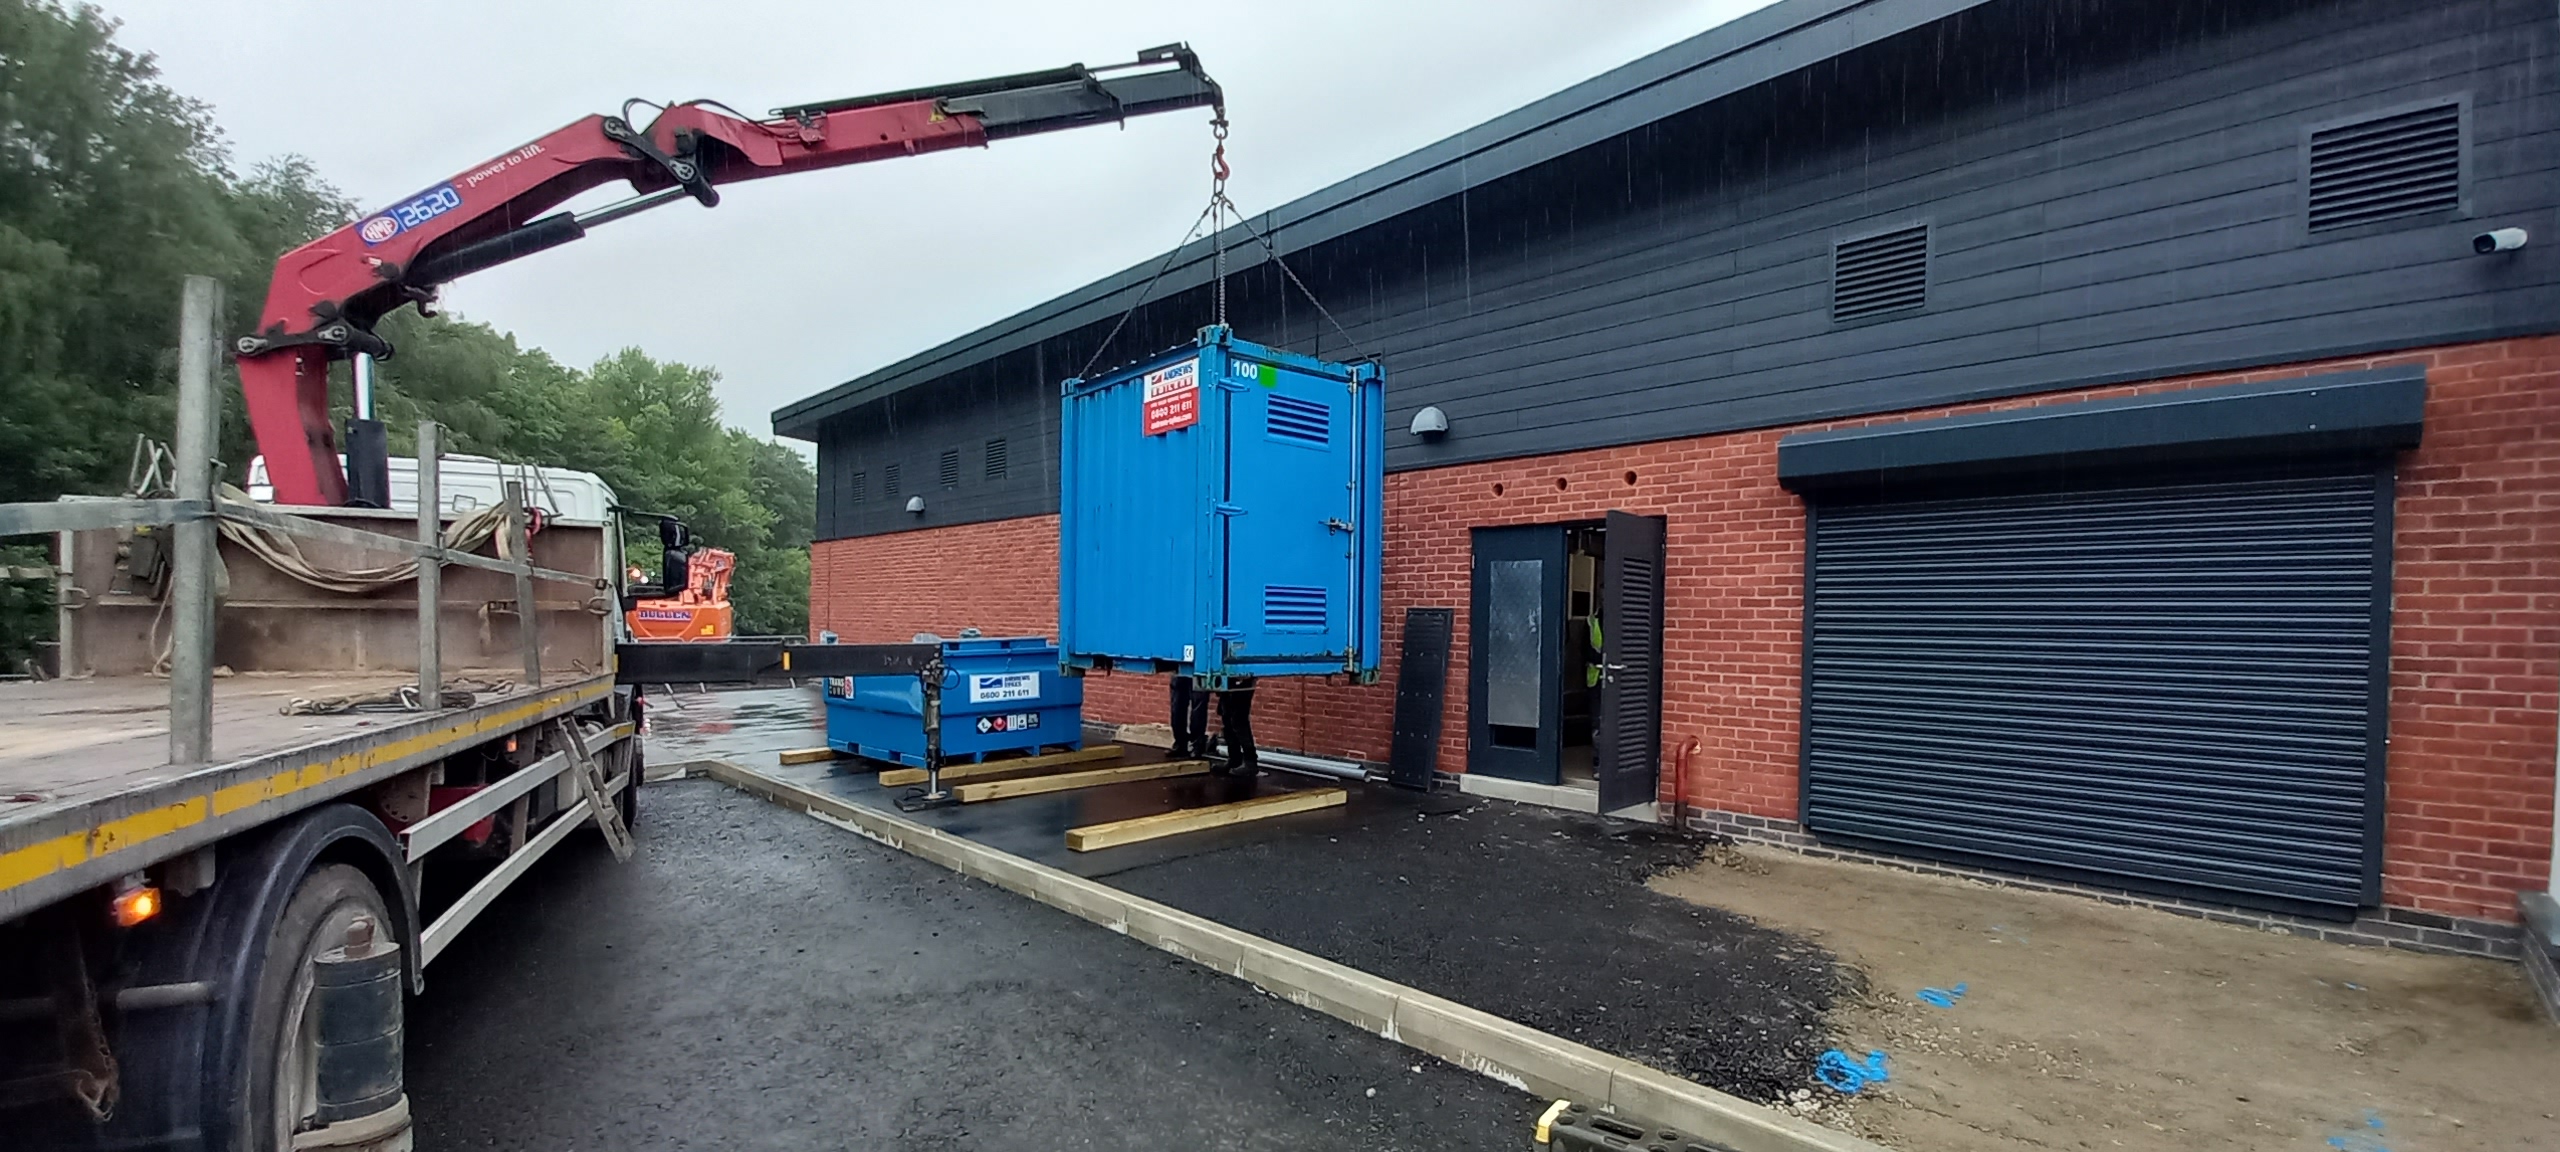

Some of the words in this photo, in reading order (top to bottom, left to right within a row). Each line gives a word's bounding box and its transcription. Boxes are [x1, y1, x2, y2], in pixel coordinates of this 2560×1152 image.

[466, 162, 507, 188] power
[506, 152, 522, 168] to
[398, 187, 460, 227] 2620
[367, 219, 395, 240] HMF
[1233, 361, 1258, 379] 100
[1169, 402, 1180, 415] 211
[1181, 399, 1192, 411] 611
